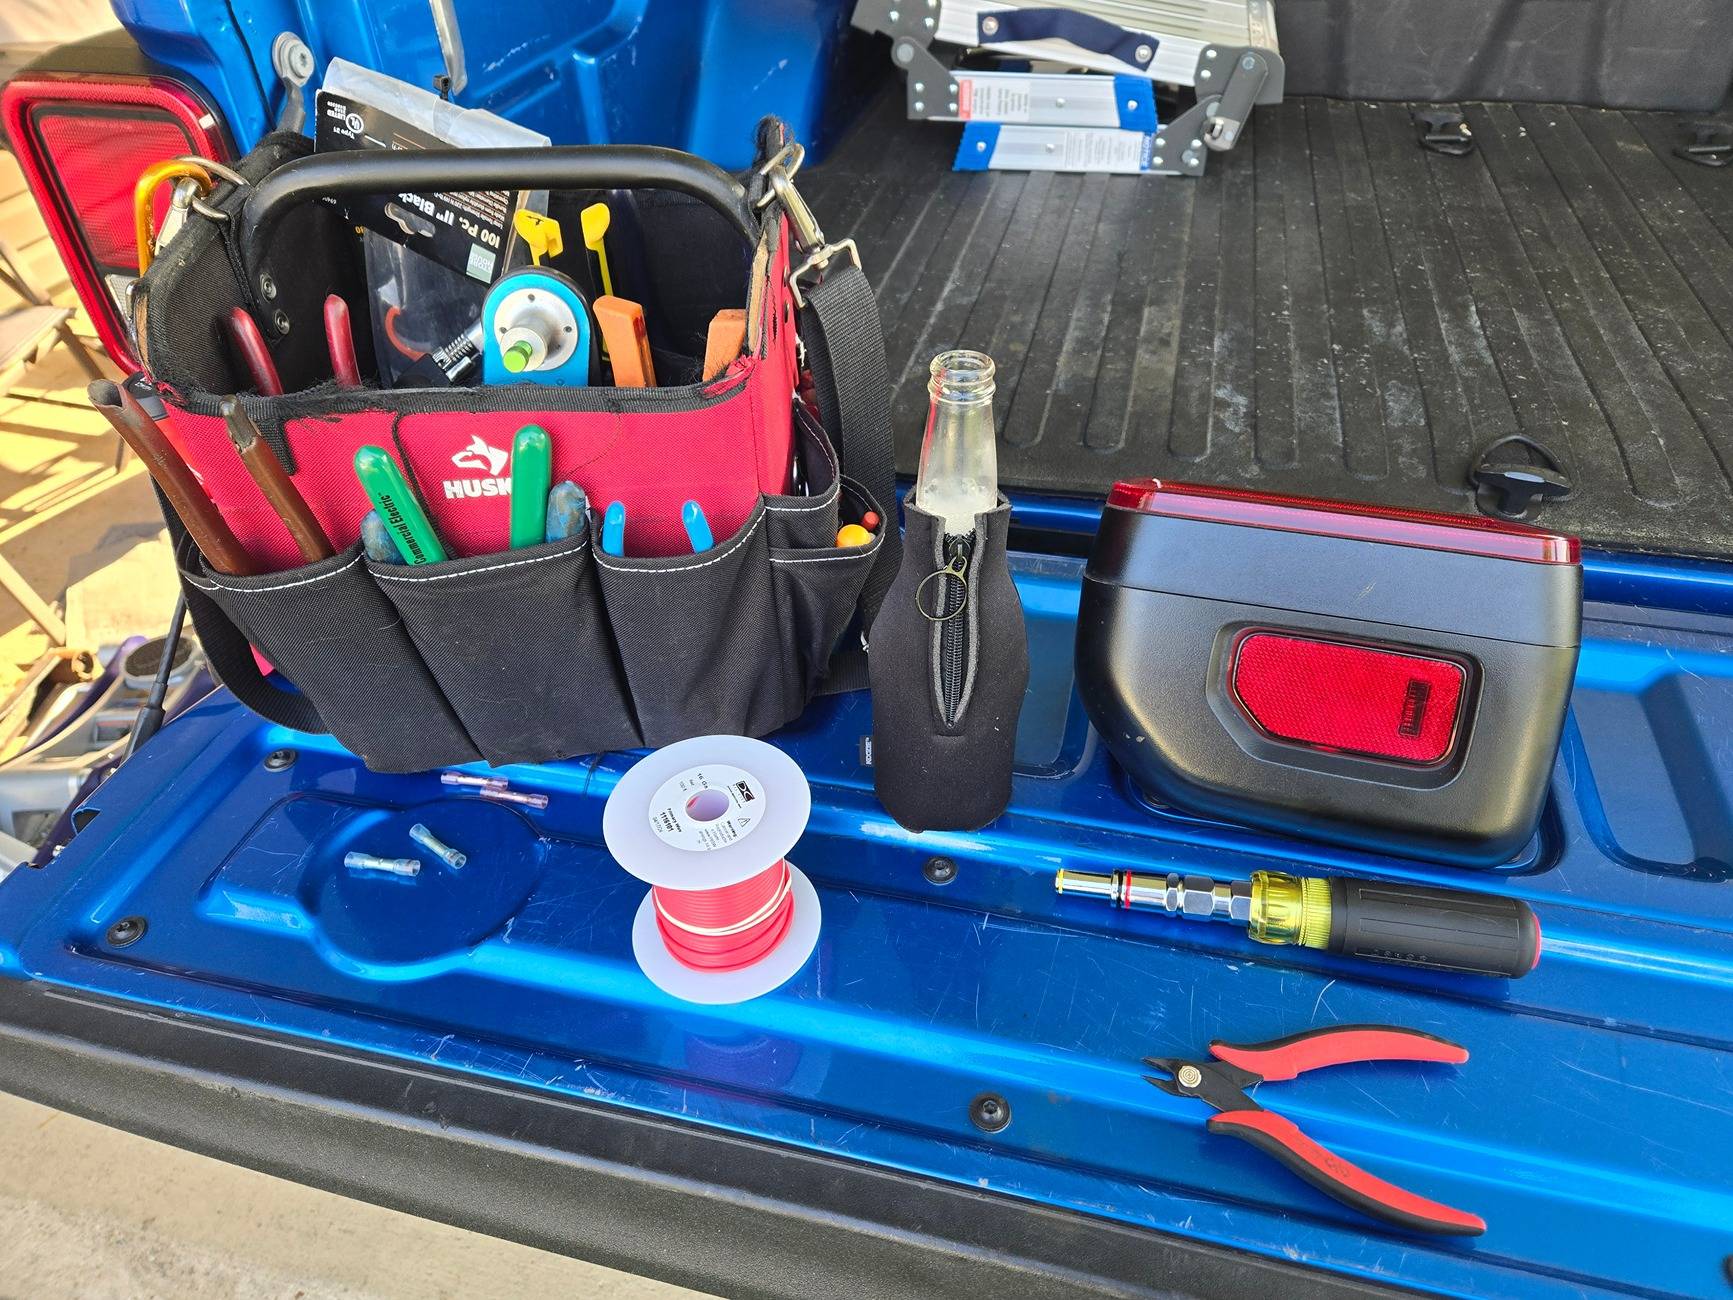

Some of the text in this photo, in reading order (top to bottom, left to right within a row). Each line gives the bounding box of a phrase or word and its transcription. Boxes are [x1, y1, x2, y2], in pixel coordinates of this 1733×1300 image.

[340, 129, 355, 139] Type
[459, 217, 479, 238] Pc.
[480, 229, 500, 249] 100
[443, 477, 512, 499] HUSK
[379, 495, 427, 565] Commercial Electric
[667, 808, 677, 823] Primary
